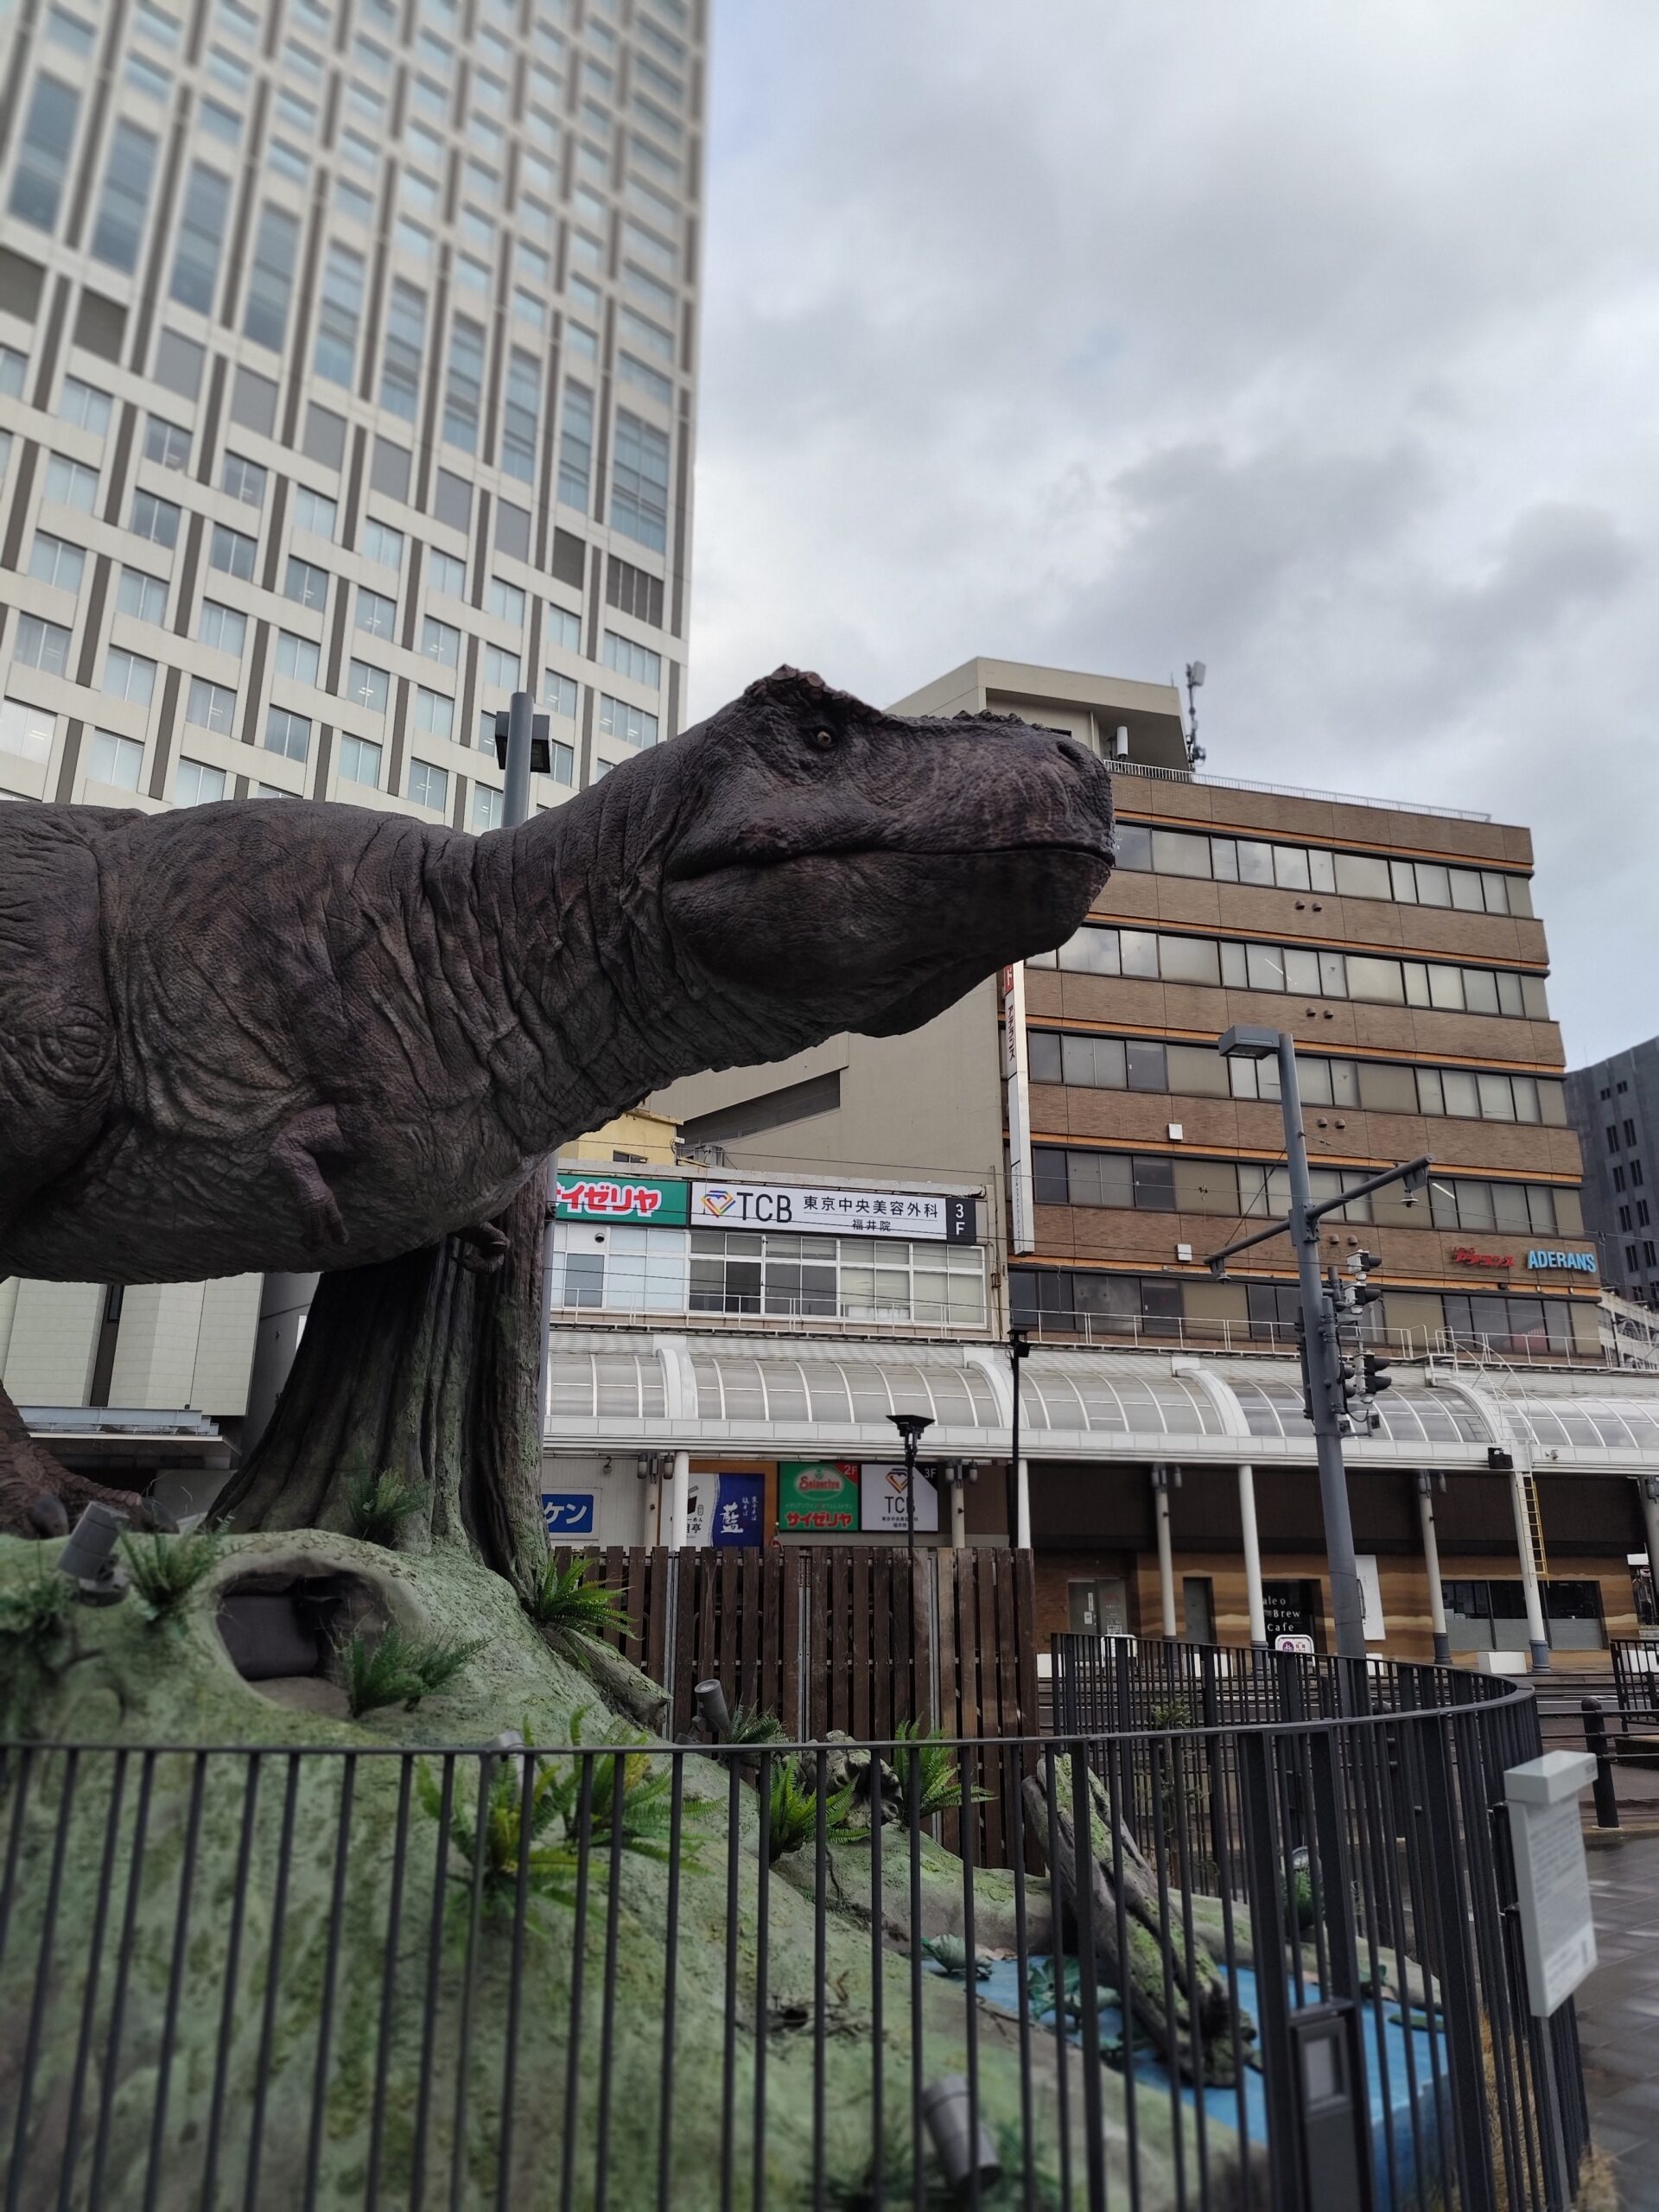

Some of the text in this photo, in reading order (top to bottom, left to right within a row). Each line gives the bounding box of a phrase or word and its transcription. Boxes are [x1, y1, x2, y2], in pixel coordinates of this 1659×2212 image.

[1007, 1004, 1016, 1063] アデランス
[737, 1192, 792, 1224] TCB
[804, 1195, 938, 1219] 東京中央美容外科
[852, 1218, 891, 1232] 福井院
[1528, 1250, 1597, 1273] ADERANS
[844, 1465, 858, 1476] 2F
[925, 1468, 937, 1478] 3F
[543, 1501, 588, 1525] ケン
[785, 1510, 853, 1529] サイゼリヤ
[1262, 1595, 1286, 1605] aleo
[1273, 1609, 1300, 1618] Brew
[1267, 1622, 1294, 1632] Cafe
